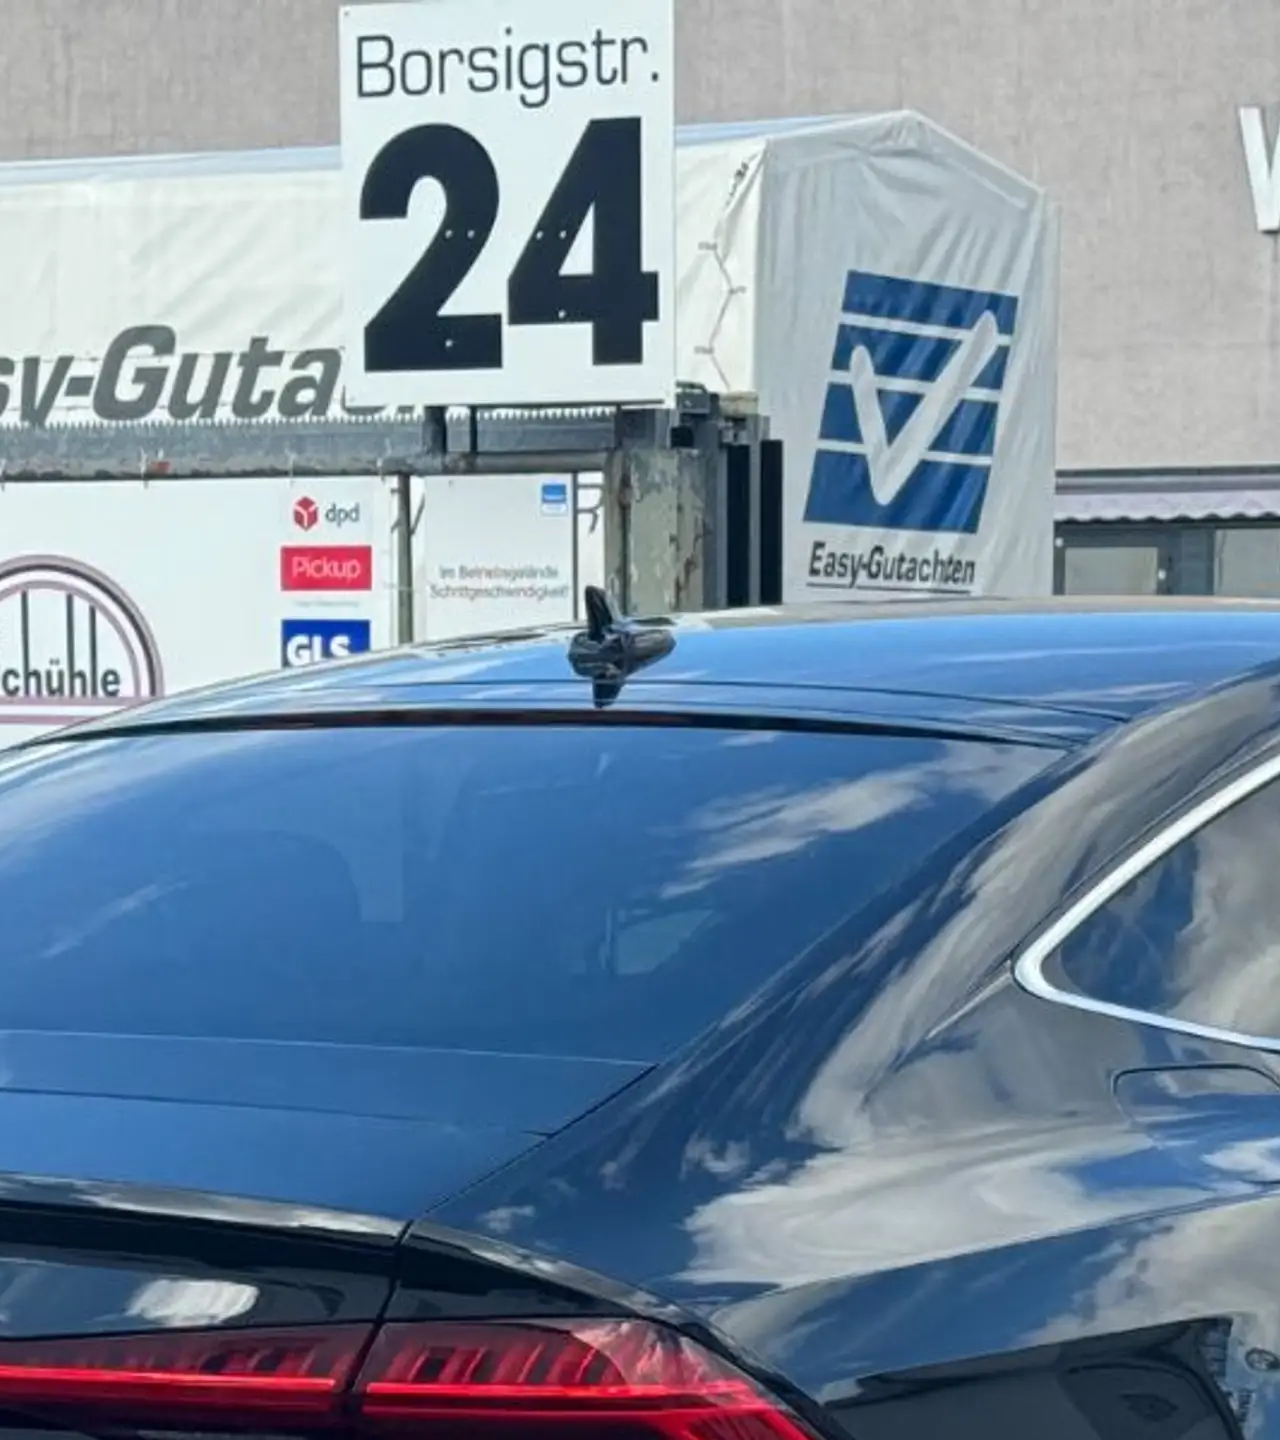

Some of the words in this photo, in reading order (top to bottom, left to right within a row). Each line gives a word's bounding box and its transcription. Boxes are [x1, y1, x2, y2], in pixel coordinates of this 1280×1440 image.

[356, 27, 659, 109] Borsigstr.
[359, 116, 660, 373] 24
[325, 502, 360, 528] dpd
[291, 556, 361, 584] Pickup
[808, 540, 976, 589] Easy-Gutachten
